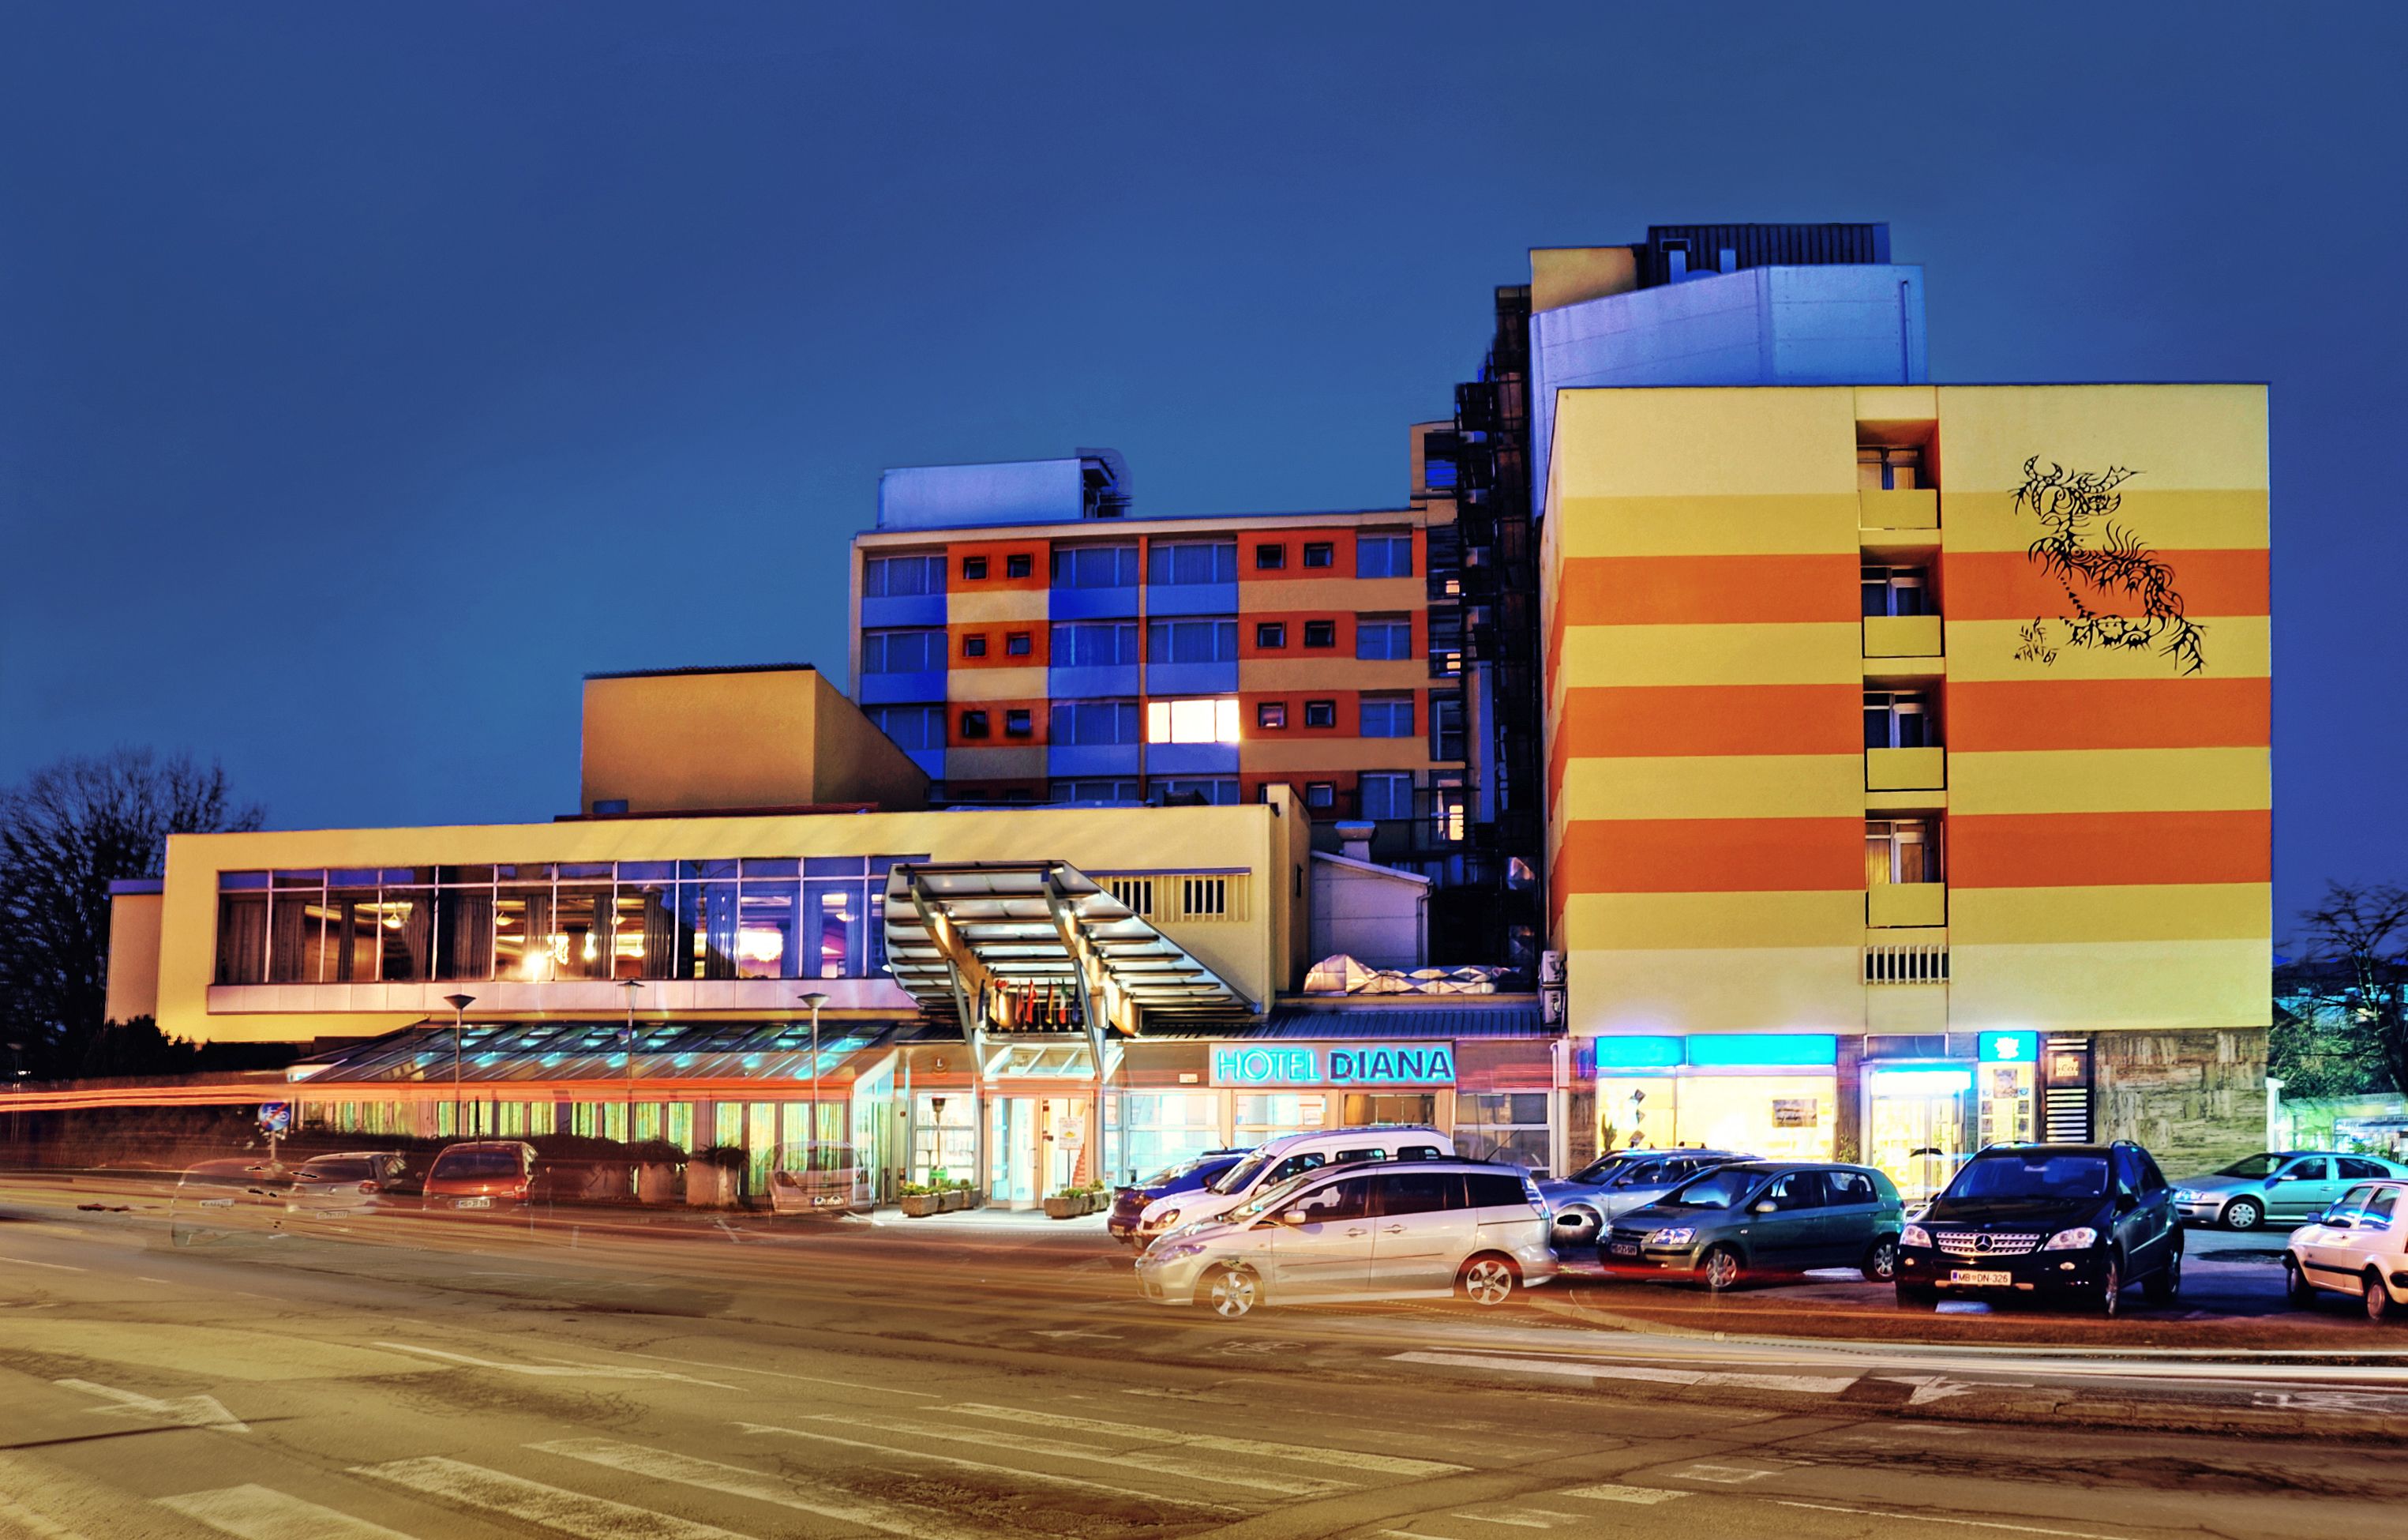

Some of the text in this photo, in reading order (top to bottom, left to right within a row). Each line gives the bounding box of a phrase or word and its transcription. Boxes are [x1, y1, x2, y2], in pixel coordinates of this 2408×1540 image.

[1217, 1049, 1453, 1081] HOTEL DIANA
[1958, 1273, 1971, 1282] MB
